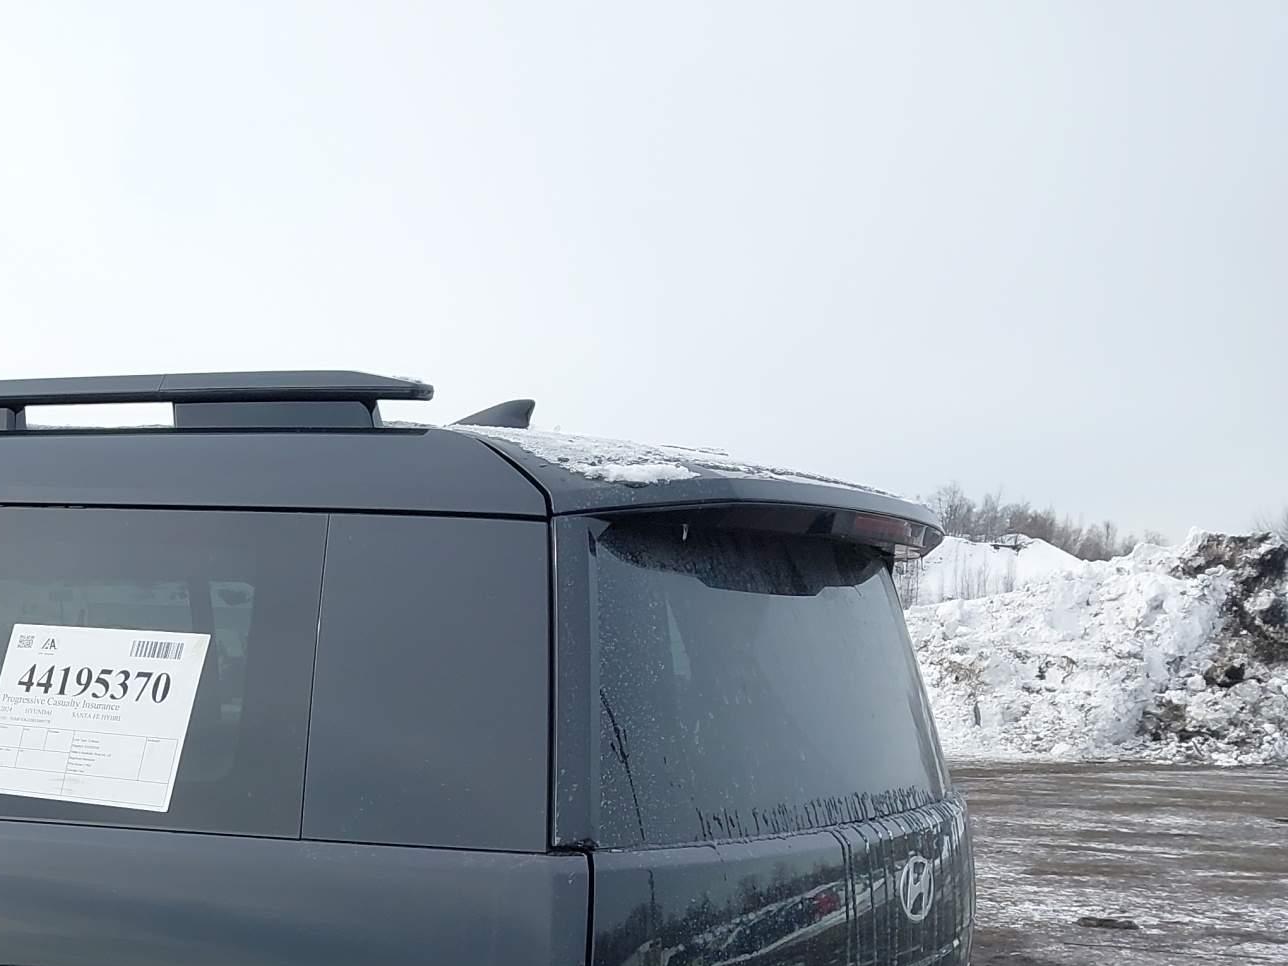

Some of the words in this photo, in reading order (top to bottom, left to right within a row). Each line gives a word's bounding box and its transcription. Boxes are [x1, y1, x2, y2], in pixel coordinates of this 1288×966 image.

[18, 663, 171, 704] 44195370
[2, 693, 45, 707] Progressive
[47, 698, 81, 710] Casualty
[82, 699, 121, 711] Insurance
